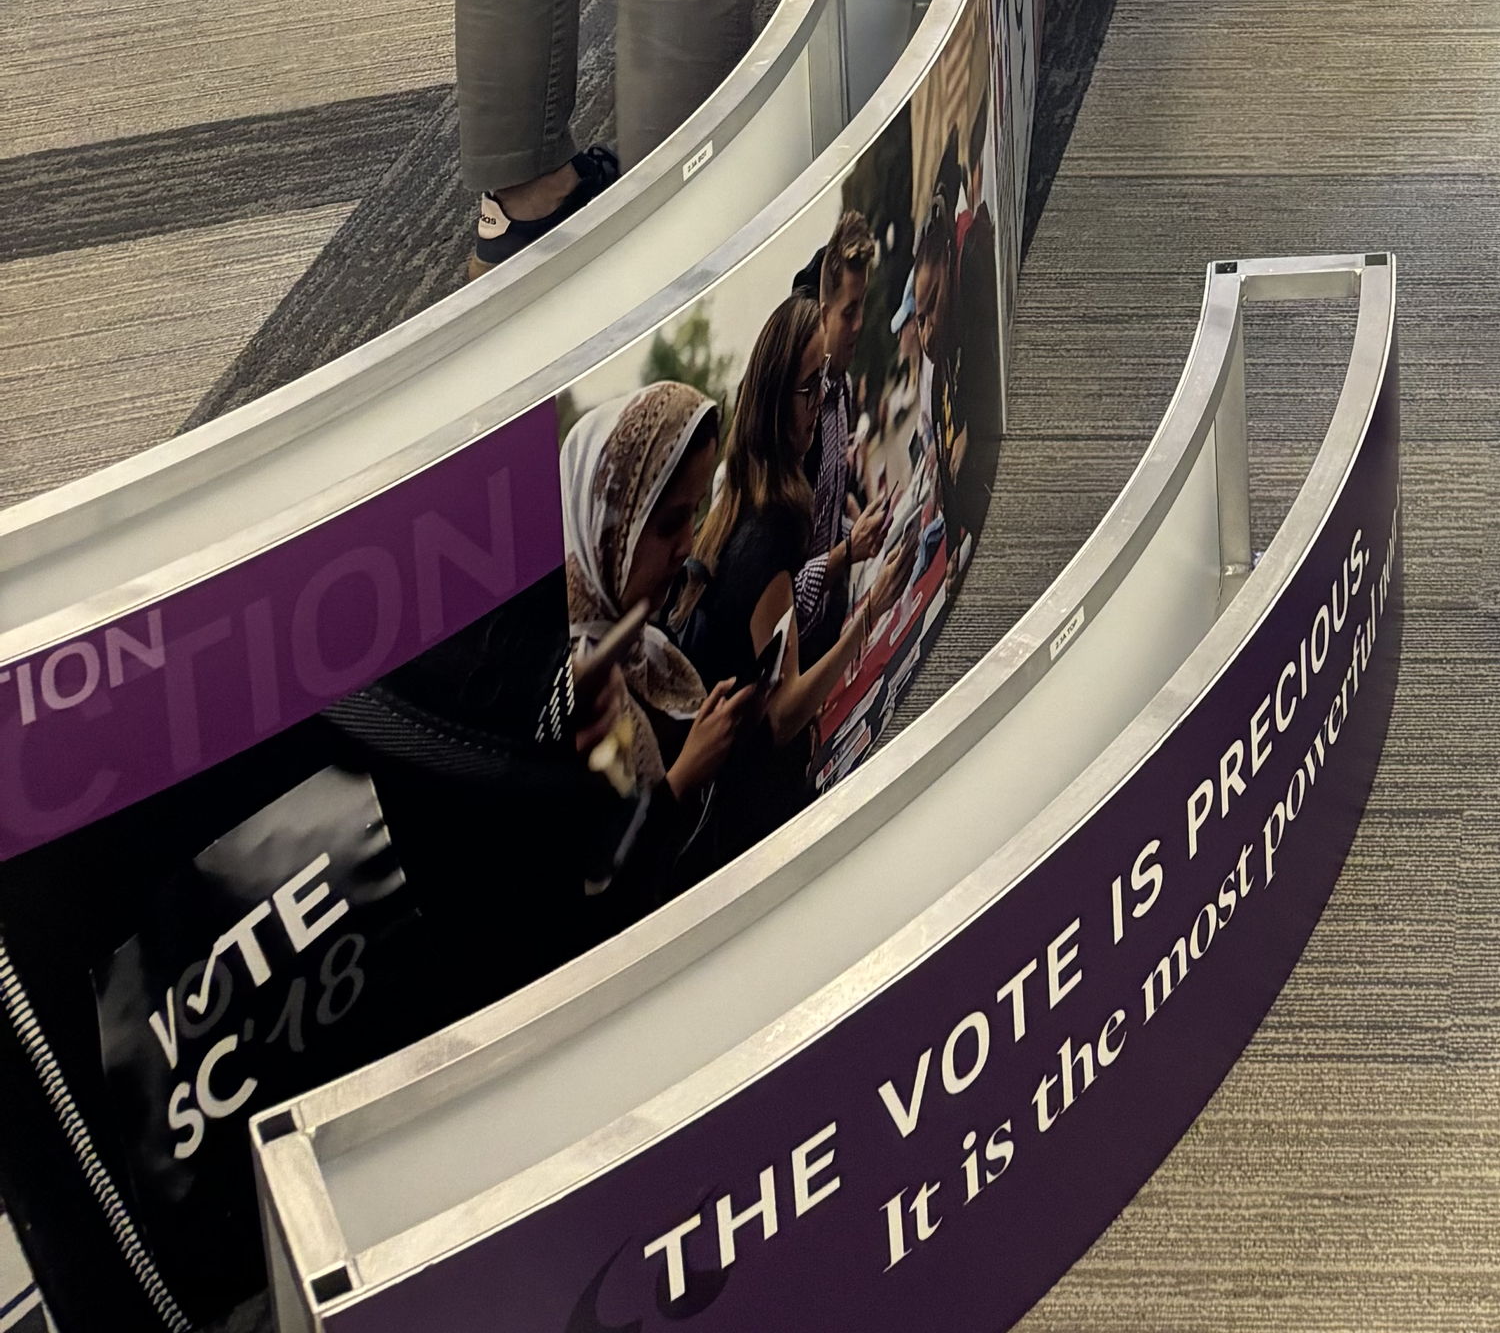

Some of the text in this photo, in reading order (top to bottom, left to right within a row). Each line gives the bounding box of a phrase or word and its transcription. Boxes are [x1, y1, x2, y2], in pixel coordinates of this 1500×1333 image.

[0, 608, 167, 726] ION
[643, 1121, 841, 1302] THE
[877, 917, 1084, 1139] VOTE
[1111, 839, 1164, 946] IS
[1186, 528, 1370, 861] PRECIOUS.
[879, 582, 1378, 1274] It is the most powerful
